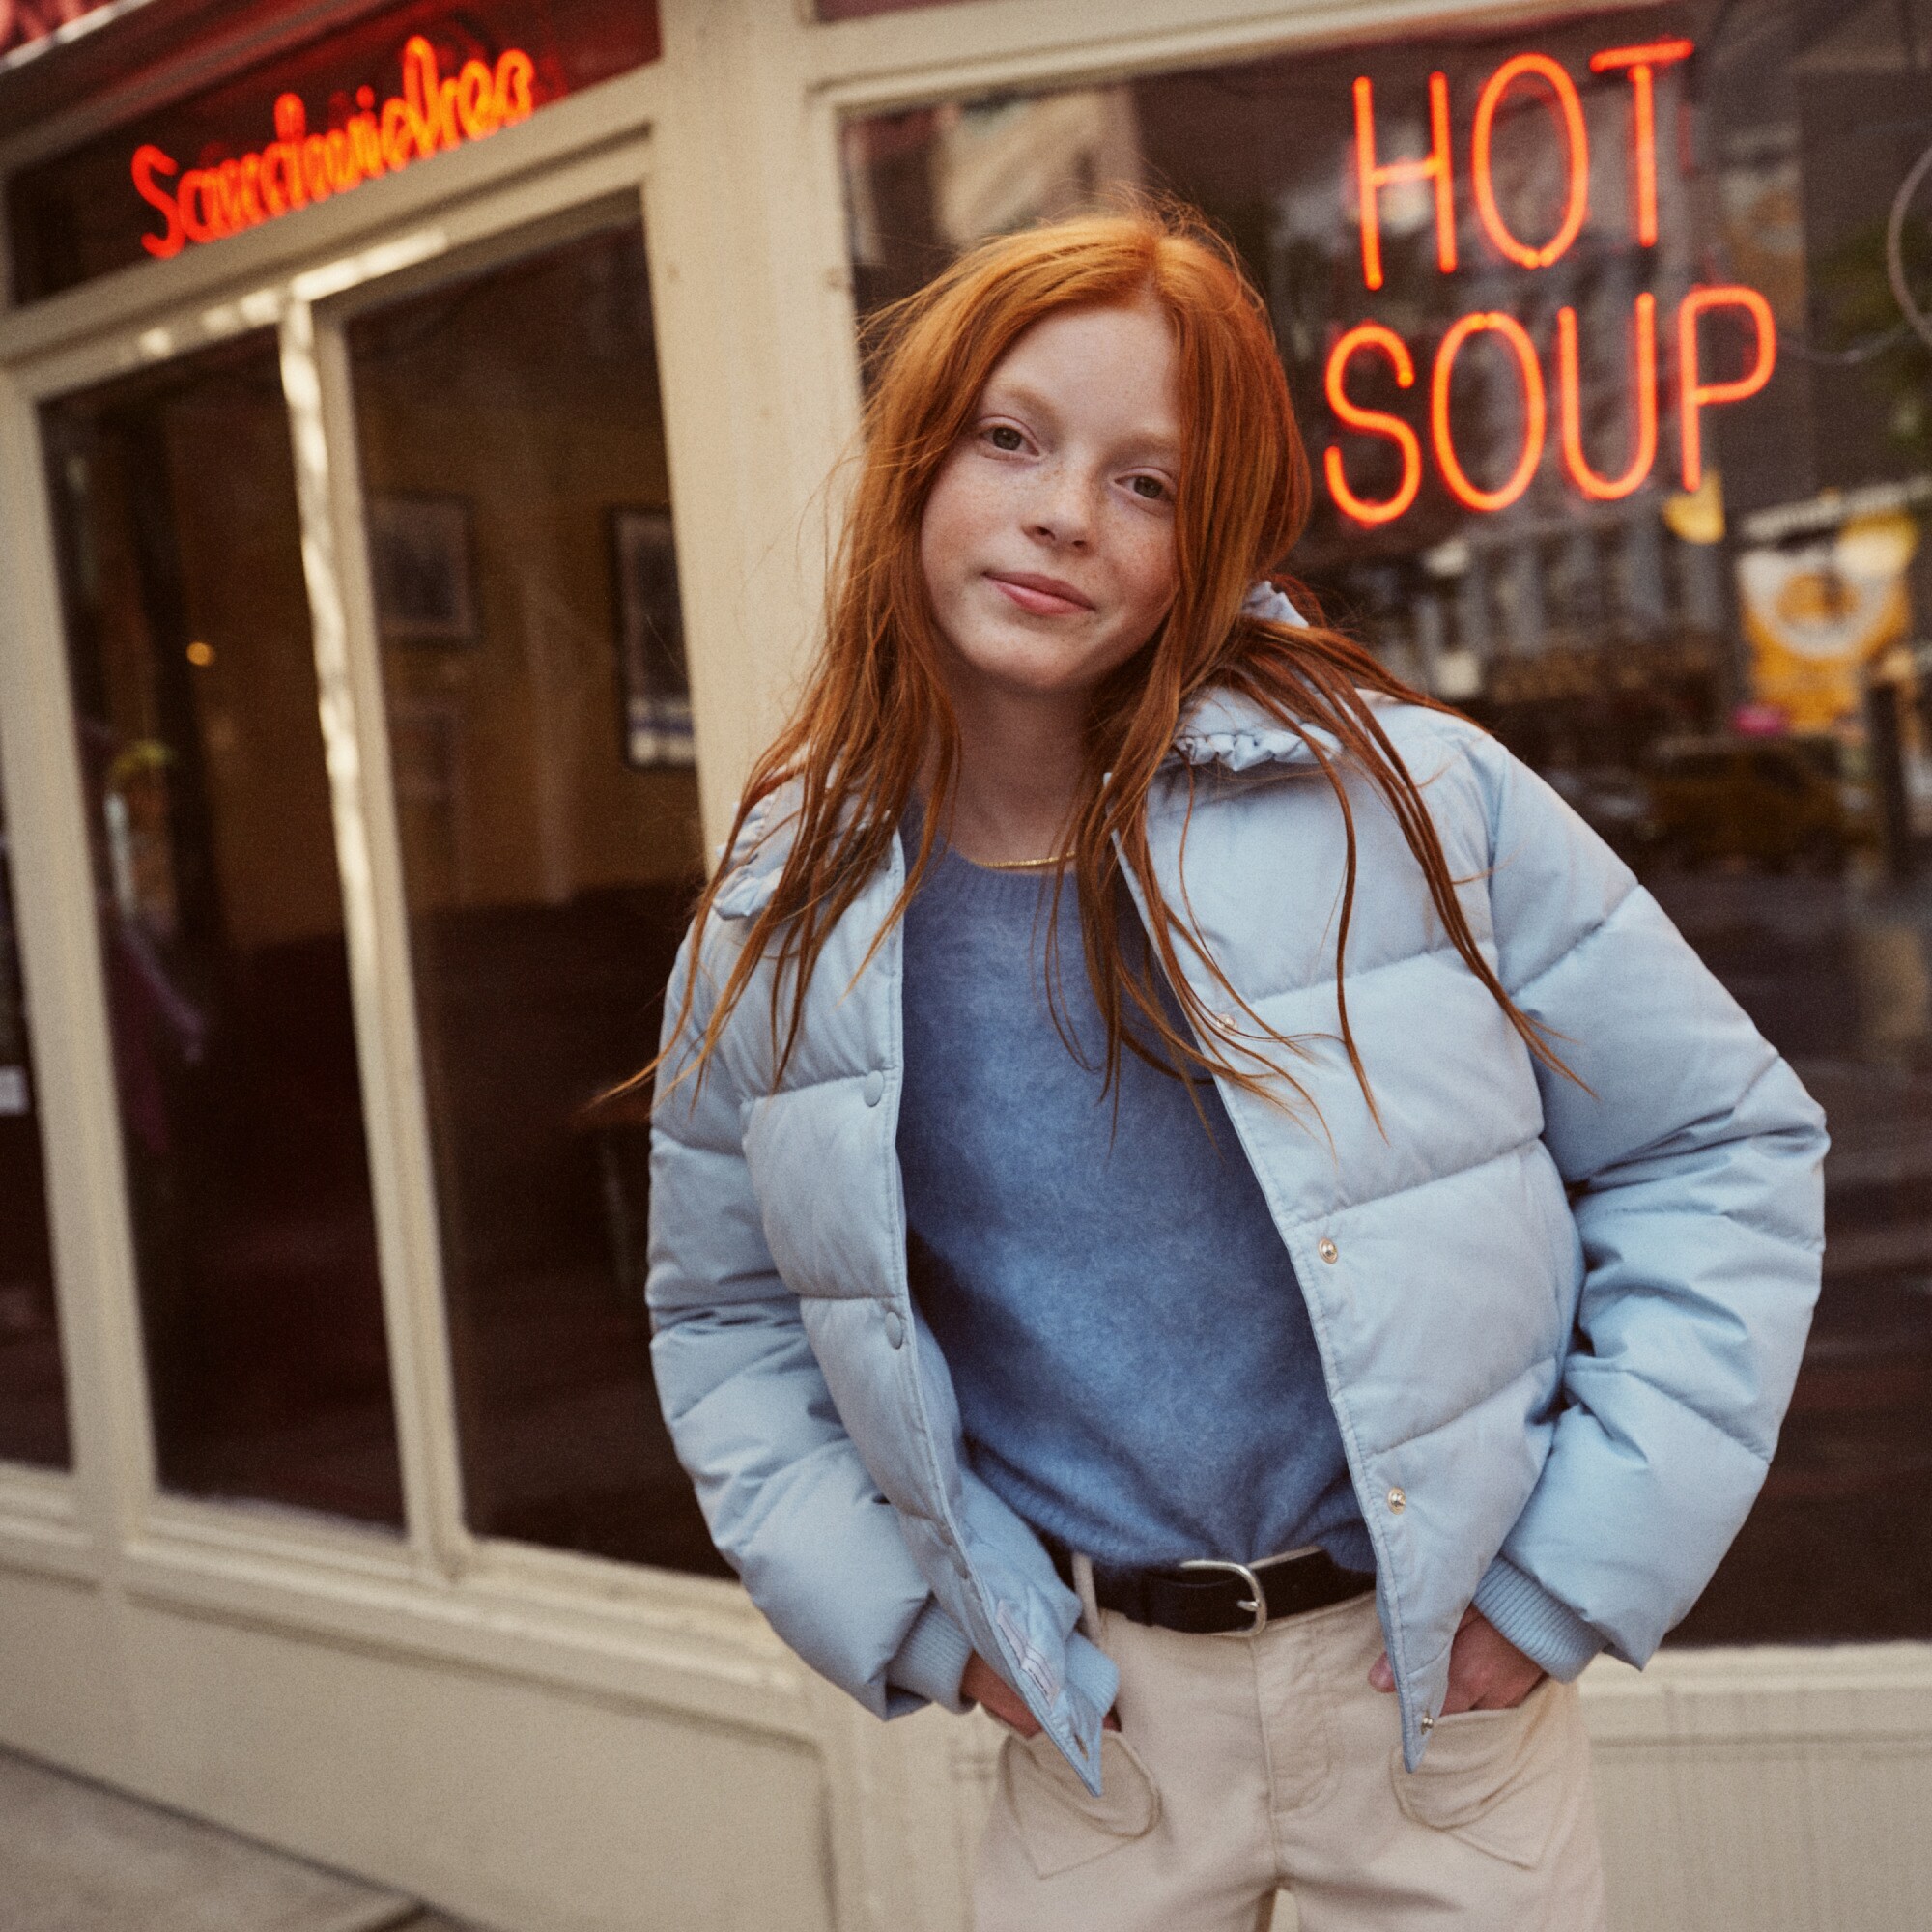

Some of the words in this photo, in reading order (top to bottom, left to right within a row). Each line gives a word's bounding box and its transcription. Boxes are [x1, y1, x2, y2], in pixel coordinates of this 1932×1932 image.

[131, 35, 534, 259] Sandwiches
[1353, 39, 1693, 291] HOT
[1324, 284, 1776, 526] SOUP
